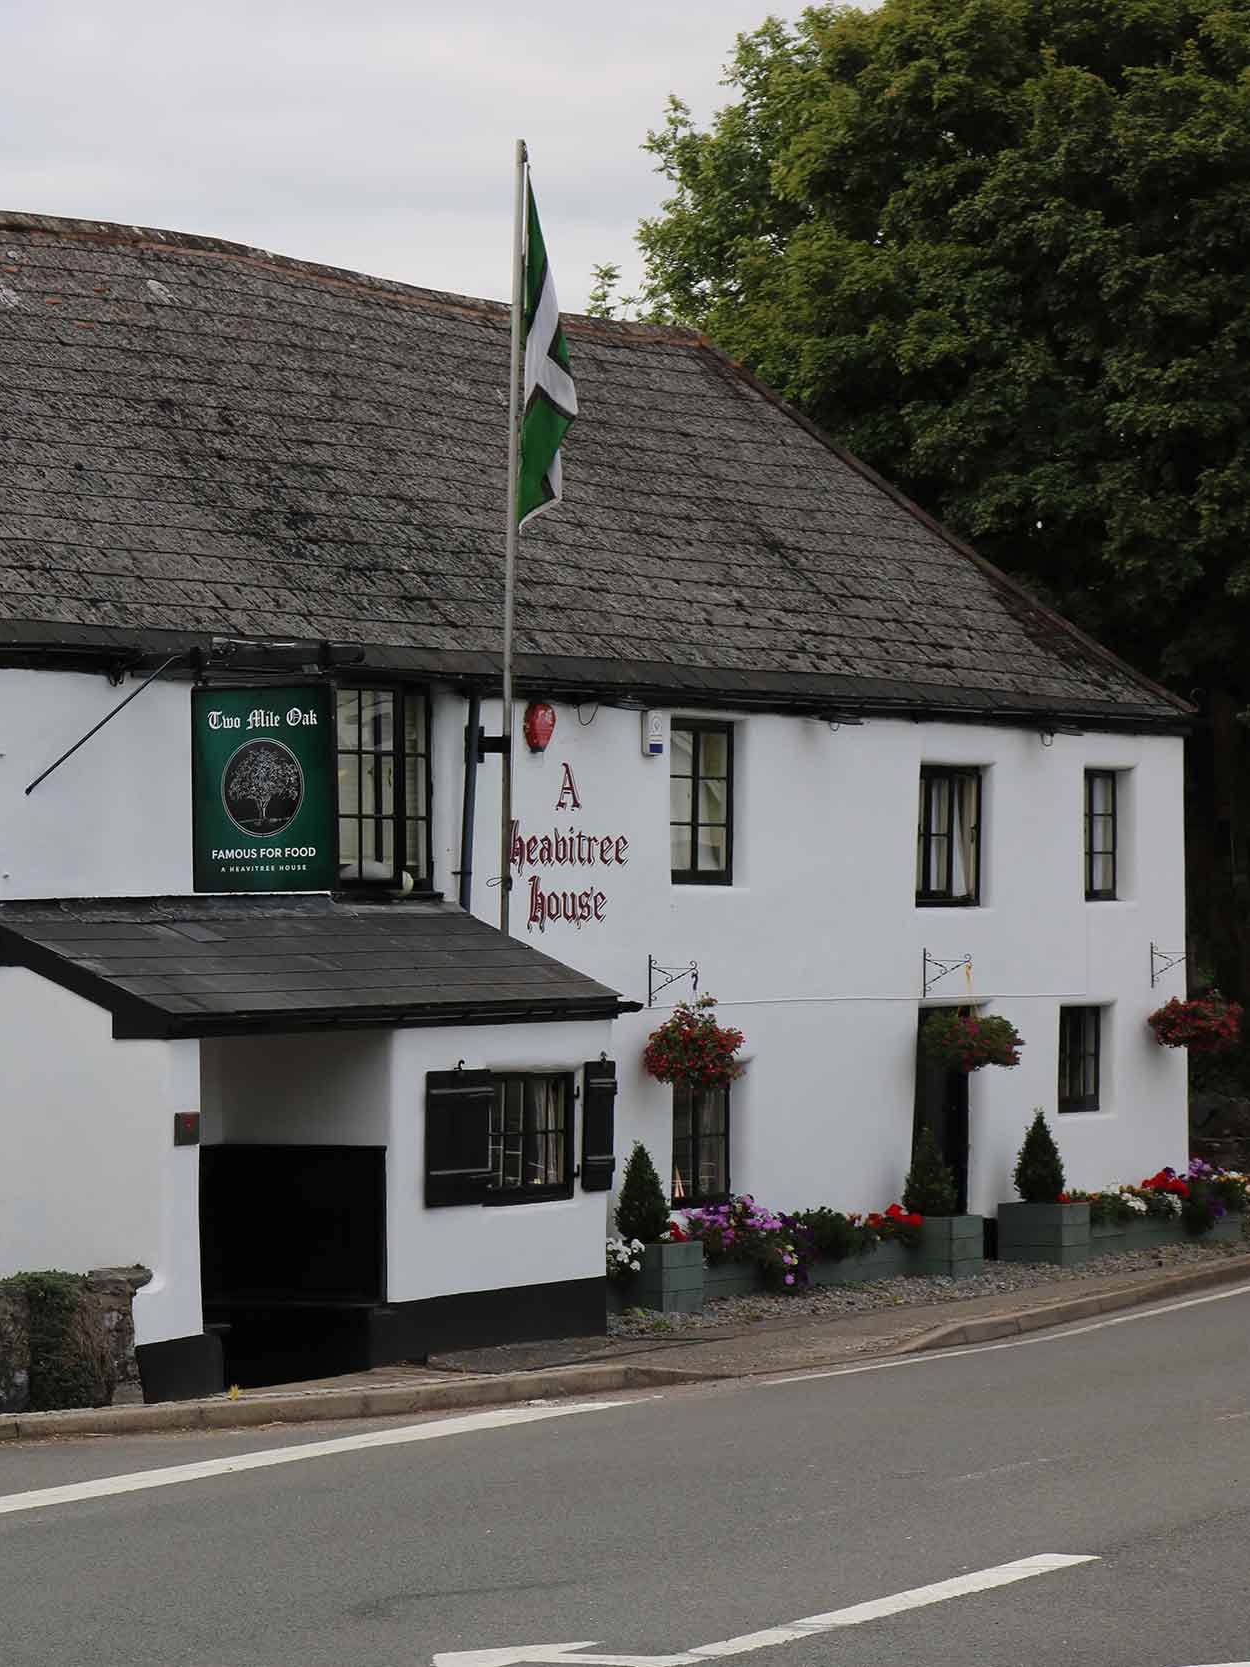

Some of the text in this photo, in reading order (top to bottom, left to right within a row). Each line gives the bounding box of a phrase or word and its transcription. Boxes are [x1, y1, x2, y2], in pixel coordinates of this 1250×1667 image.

[207, 707, 319, 731] Two Mile Oak
[555, 762, 583, 811] A
[211, 847, 317, 860] FAMOUS FOR FOOD
[229, 865, 275, 873] HEAVITREE
[279, 864, 307, 872] HOUSE
